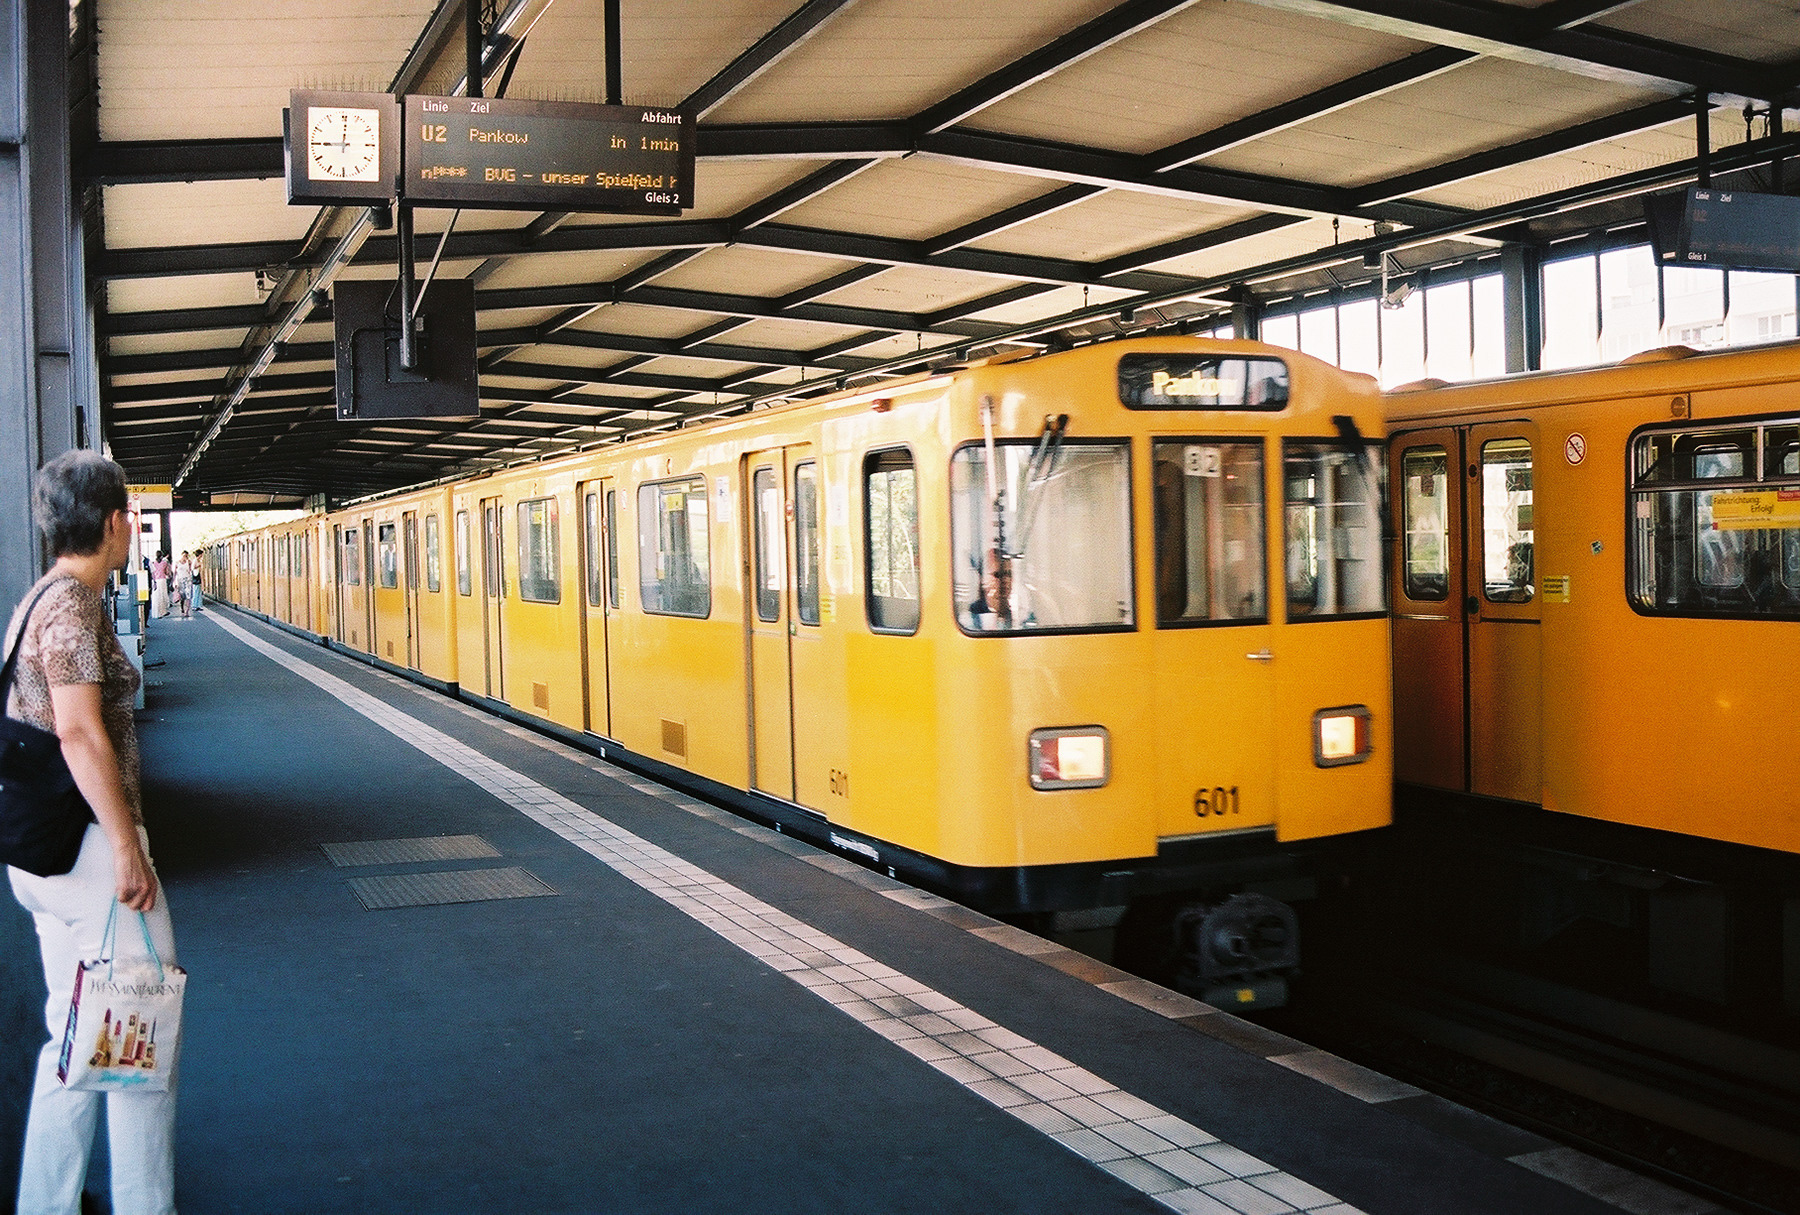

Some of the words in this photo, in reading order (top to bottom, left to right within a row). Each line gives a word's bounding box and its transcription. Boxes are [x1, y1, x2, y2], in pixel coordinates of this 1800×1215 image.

[422, 100, 449, 113] Linie
[470, 101, 490, 114] Ziel
[641, 111, 682, 125] Abfahrt
[421, 124, 448, 143] U2
[469, 128, 529, 144] Pankow
[610, 135, 627, 149] in
[485, 168, 516, 182] BVG
[541, 173, 589, 185] unser
[596, 172, 662, 190] Spielfeld
[645, 191, 671, 205] Gleis
[673, 193, 680, 205] 2
[1695, 191, 1710, 201] Linie
[1720, 194, 1732, 203] Ziel
[1688, 251, 1703, 261] Gleis
[829, 768, 849, 799] 601
[1194, 786, 1240, 817] 601
